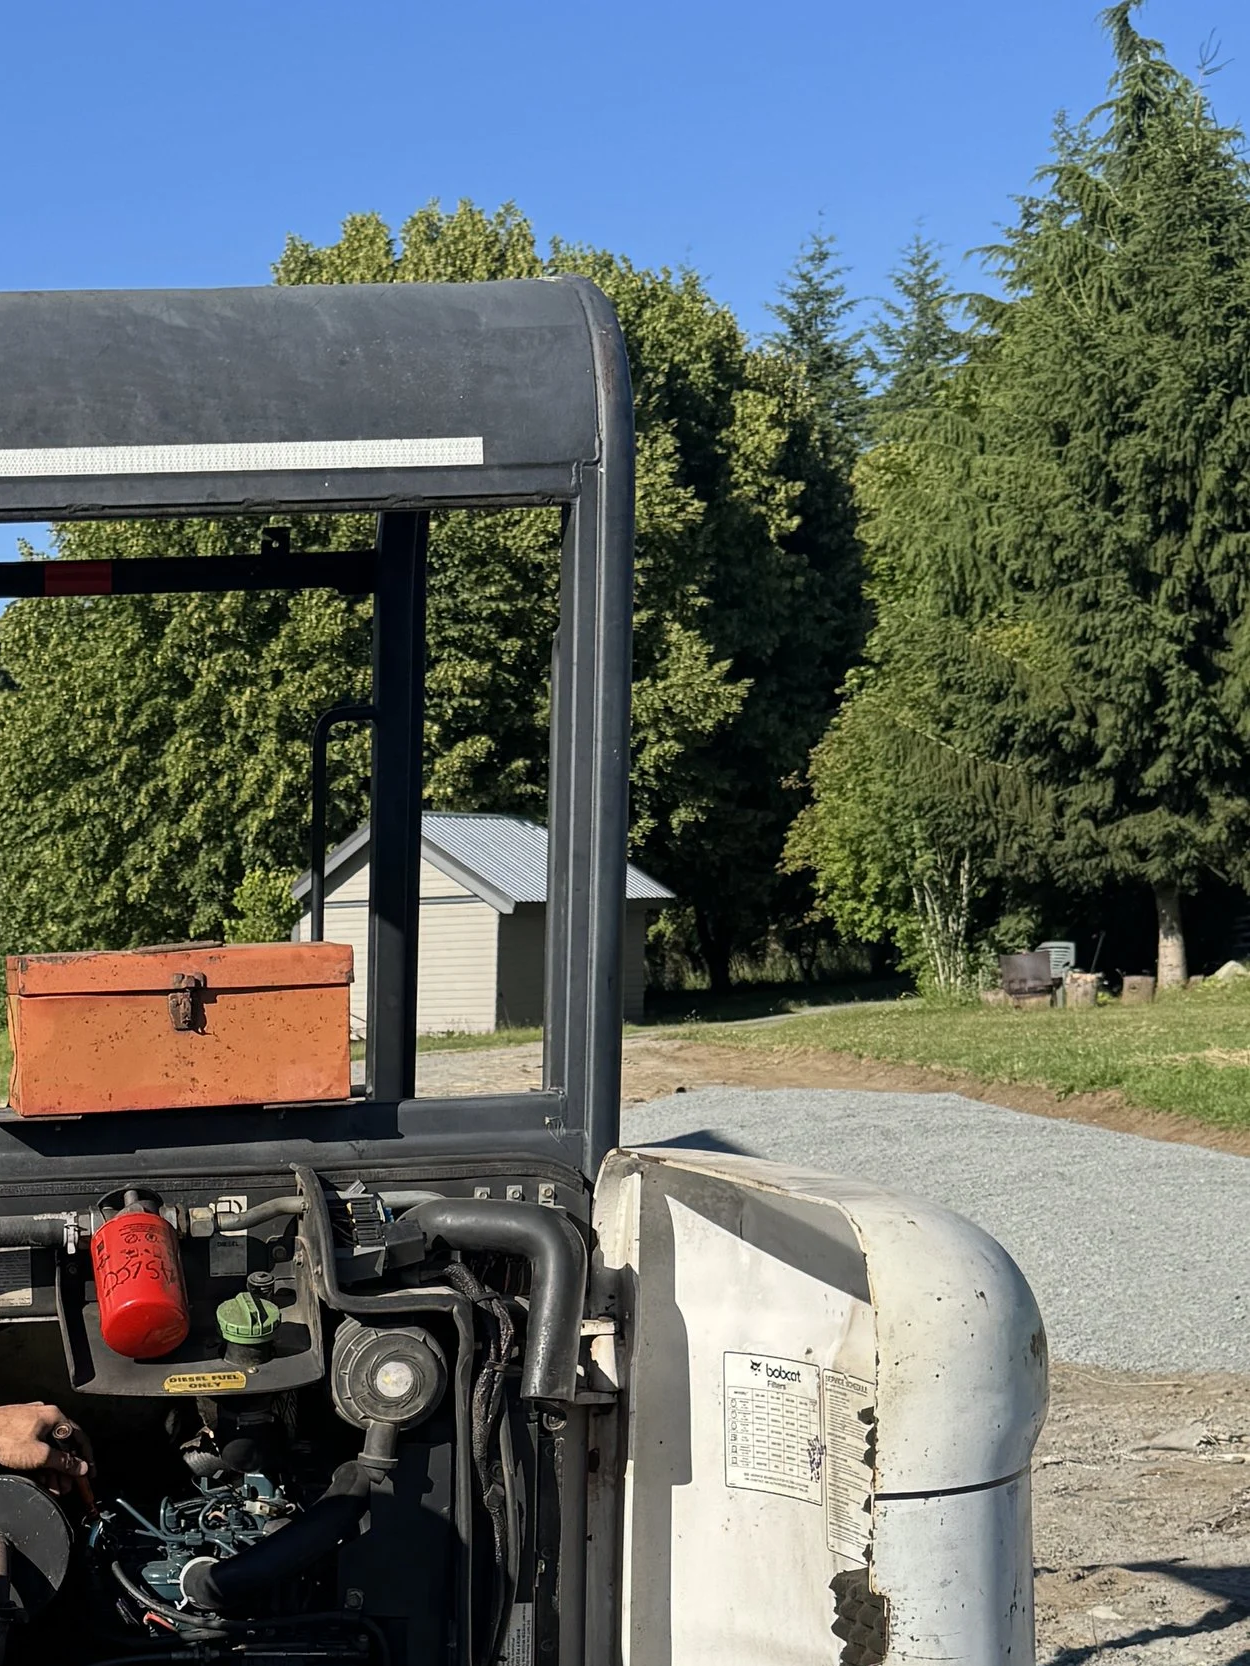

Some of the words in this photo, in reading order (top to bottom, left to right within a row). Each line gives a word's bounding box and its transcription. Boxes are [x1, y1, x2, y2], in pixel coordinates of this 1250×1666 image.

[765, 1363, 802, 1383] bobcat
[169, 1375, 208, 1383] DIESEL
[766, 1380, 787, 1391] Filters
